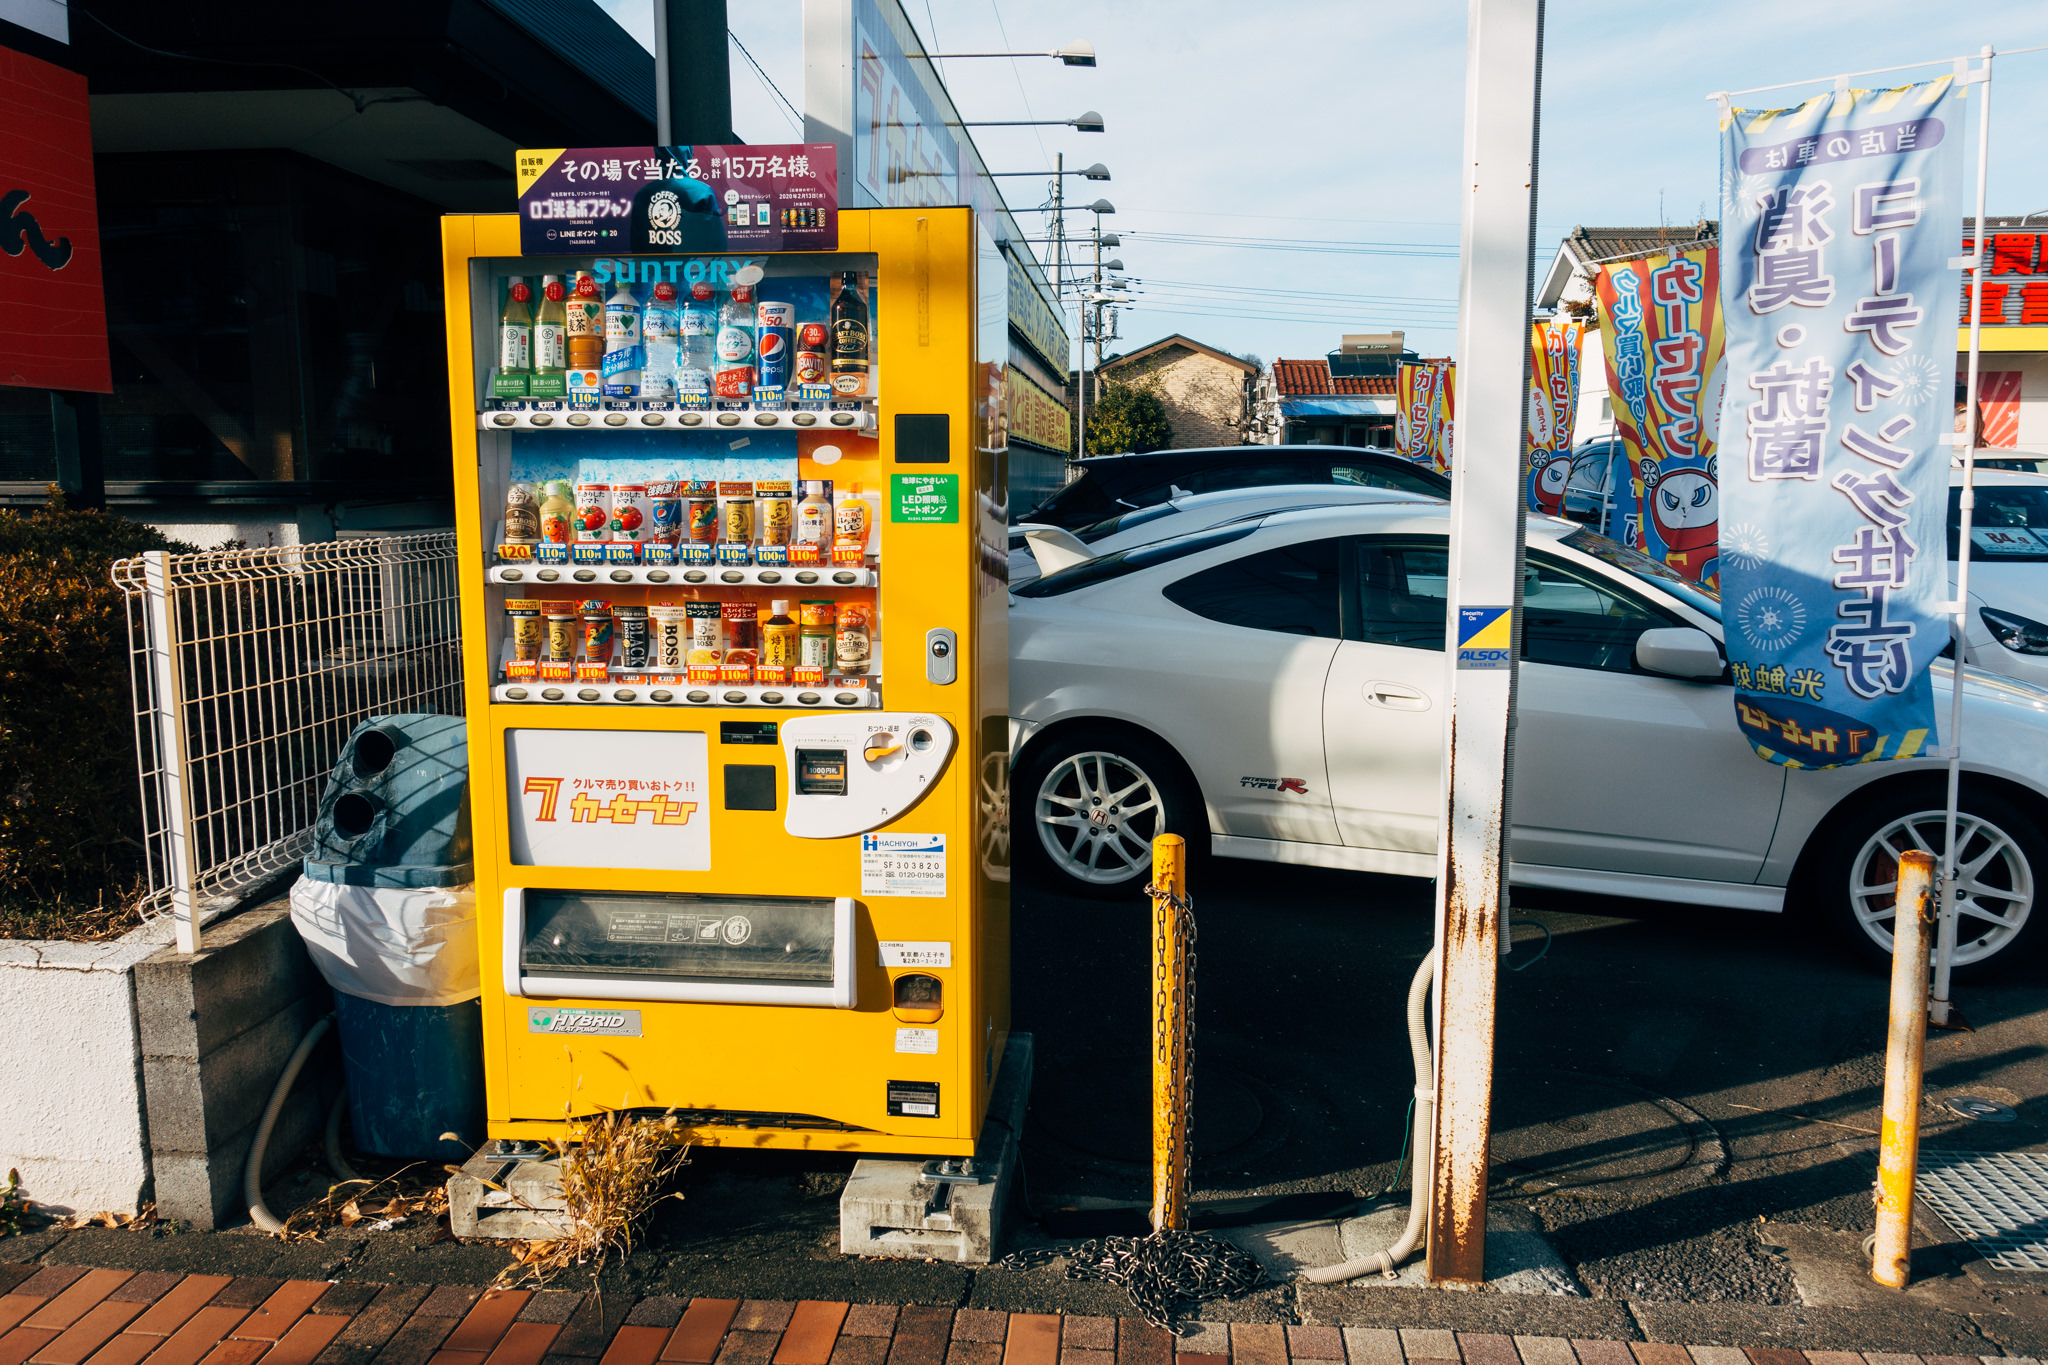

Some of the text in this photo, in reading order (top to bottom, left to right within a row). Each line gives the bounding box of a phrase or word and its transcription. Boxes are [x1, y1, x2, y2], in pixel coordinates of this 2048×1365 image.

[521, 157, 543, 166] 自販機
[522, 168, 537, 177] 限定
[561, 158, 709, 182] その場で当たる。
[723, 155, 816, 179] 15万名様。
[651, 191, 678, 203] COFFEE
[530, 199, 632, 219] ロゴ光るボスジャン
[648, 230, 682, 245] BOSS
[568, 319, 586, 332] 麦茶
[606, 349, 631, 364] ミネラル
[761, 366, 783, 374] pepsi
[1547, 327, 1570, 451] カーセブン
[572, 393, 599, 403] 110円
[680, 394, 707, 404] 100円
[755, 391, 782, 401] 110円
[802, 389, 830, 400] 110円
[1412, 371, 1431, 457] カーセブン
[1533, 391, 1547, 441] 高く買うよ!
[687, 482, 709, 490] NEW
[902, 505, 947, 514] ヒートポンプ
[540, 549, 566, 558] 110円
[575, 549, 601, 559] 110円
[606, 550, 632, 559] 110円
[645, 549, 671, 559] 110円
[682, 549, 708, 559] 110円
[720, 549, 746, 559] 110円
[759, 551, 785, 561] 100円
[790, 551, 817, 561] 110円
[834, 551, 862, 561] 110円
[582, 601, 604, 609] NEW
[629, 621, 645, 666] BLACK
[665, 624, 679, 666] BOSS
[1459, 651, 1509, 661] ALSOK
[509, 666, 535, 676] 100円
[542, 668, 568, 677] 110円
[579, 668, 605, 677] 110円
[690, 671, 716, 680] 110円
[721, 670, 748, 680] 110円
[756, 670, 784, 680] 110円
[794, 671, 821, 681] 110円
[867, 725, 900, 733] おつり・返却
[809, 767, 838, 775] 1000円札
[572, 778, 695, 792] クルマ売り買いおトク!!
[1240, 777, 1309, 794] TYPE R
[523, 777, 565, 822] 7
[570, 792, 698, 825] カーセブン
[899, 871, 944, 879] 0120-0190-88
[549, 1014, 626, 1031] HYBRID
